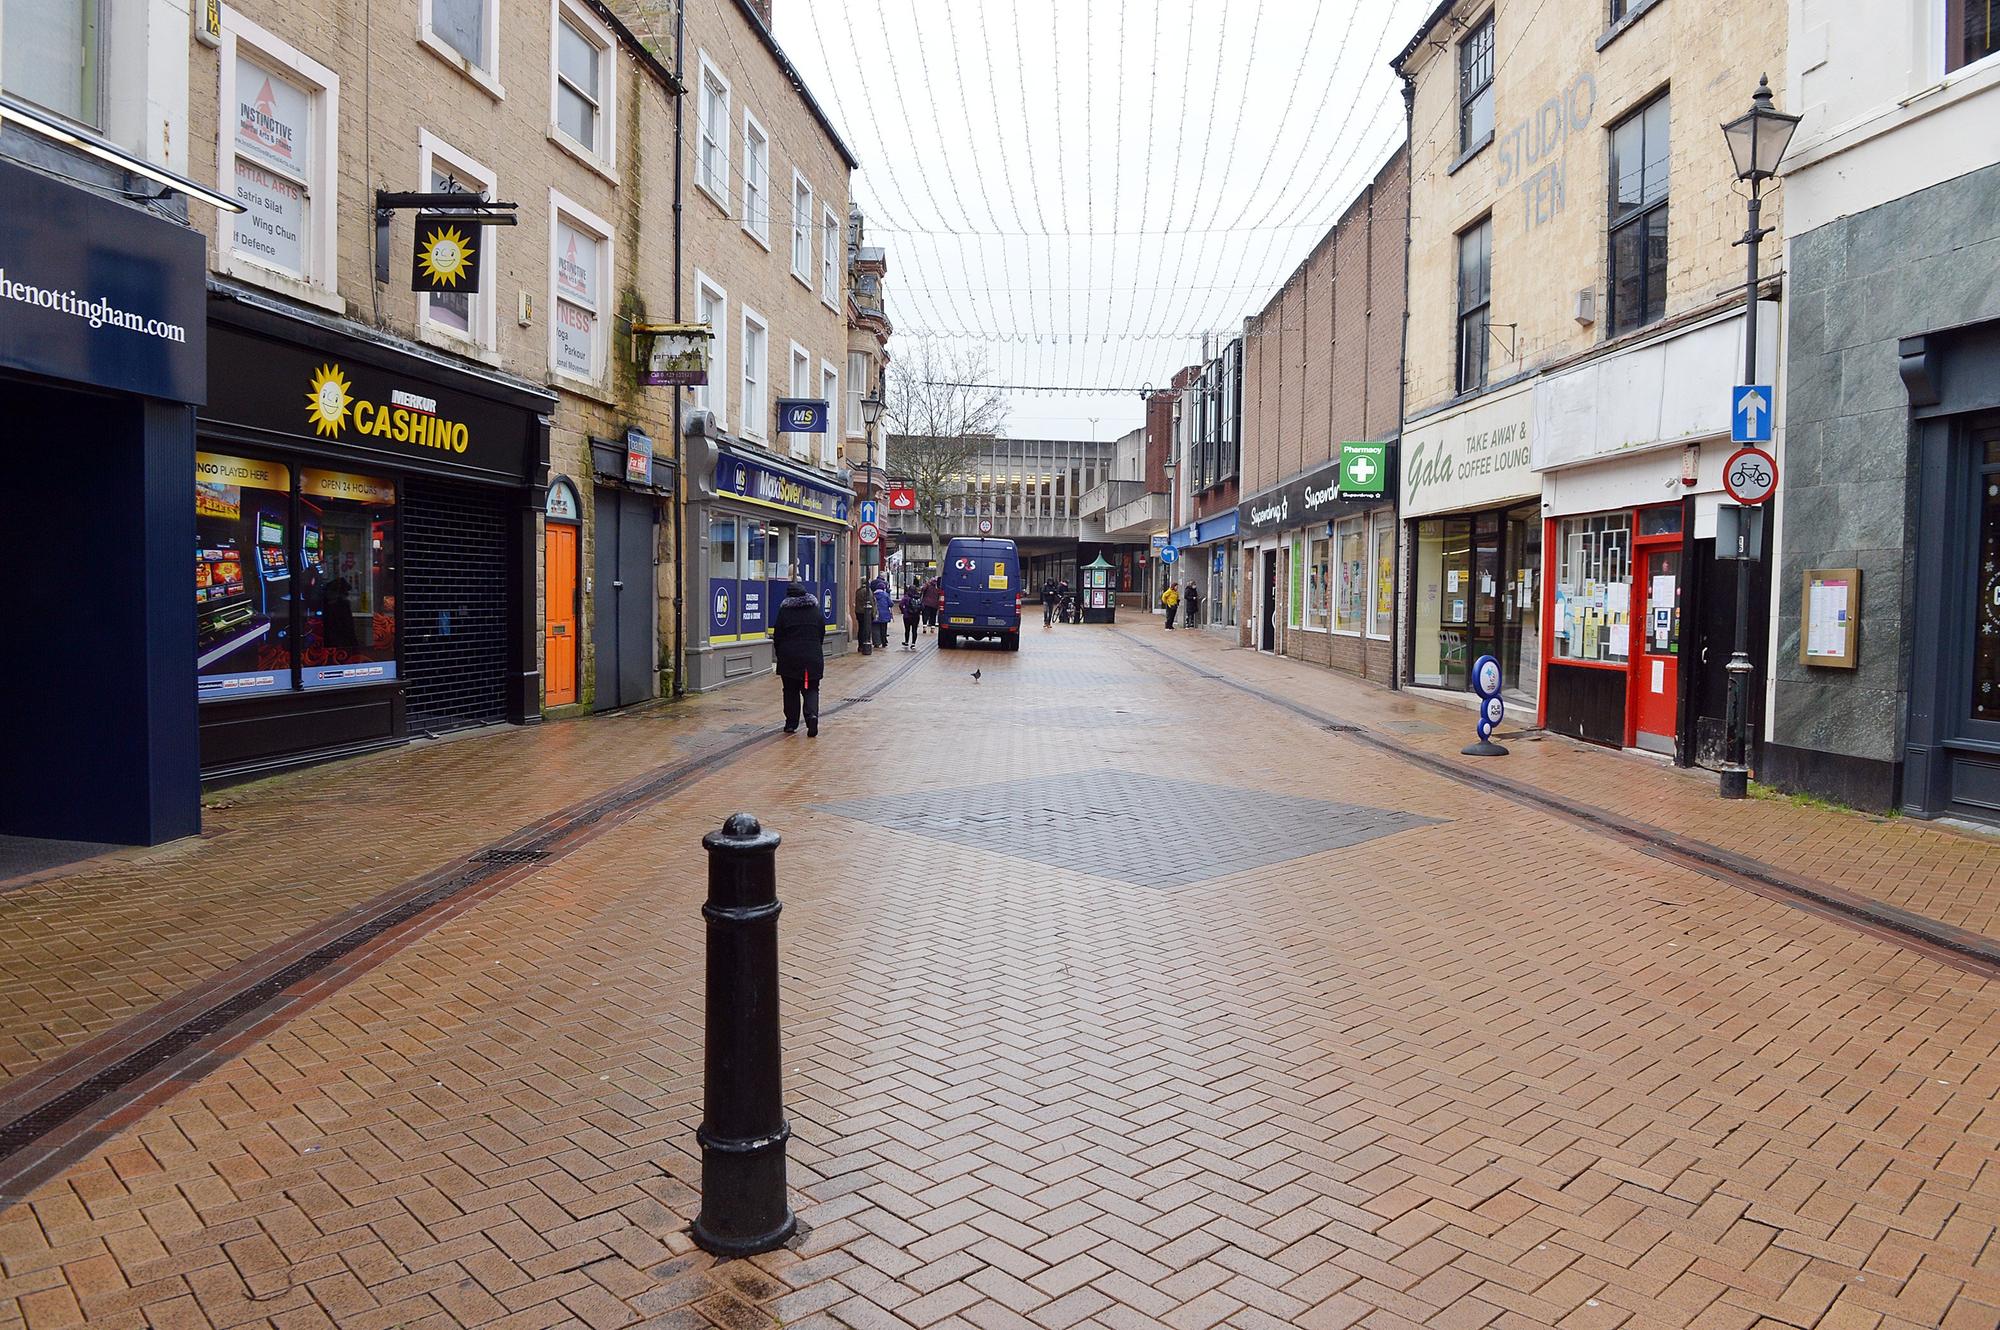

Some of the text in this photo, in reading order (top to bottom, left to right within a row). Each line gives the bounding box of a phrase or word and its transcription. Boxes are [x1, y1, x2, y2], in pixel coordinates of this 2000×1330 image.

[240, 102, 293, 142] INSTINCTIVE
[1497, 71, 1597, 188] STUDIO
[237, 186, 283, 215] Satria Silat
[271, 180, 298, 200] ARTS
[1521, 157, 1568, 232] TEN
[252, 214, 296, 242] Wing Chun
[241, 233, 276, 256] Defence
[0, 268, 186, 344] henottingham.com
[564, 343, 586, 361] Parkour
[391, 389, 437, 414] MERKUR
[353, 400, 469, 454] CASHINO
[793, 410, 813, 421] MS
[1343, 446, 1382, 454] Pharmacy
[1466, 421, 1526, 455] TAKE AWAY &
[220, 465, 249, 479] PLAYED
[250, 469, 269, 481] HERE
[735, 469, 746, 486] MS
[1408, 439, 1454, 507] Gala
[1458, 456, 1492, 481] COFFEE
[321, 479, 377, 495] OPEN 24 HOURS
[760, 470, 801, 505] MaxiSaver
[1251, 503, 1280, 527] Superdrug
[955, 558, 976, 571] G4S
[716, 595, 728, 613] MS
